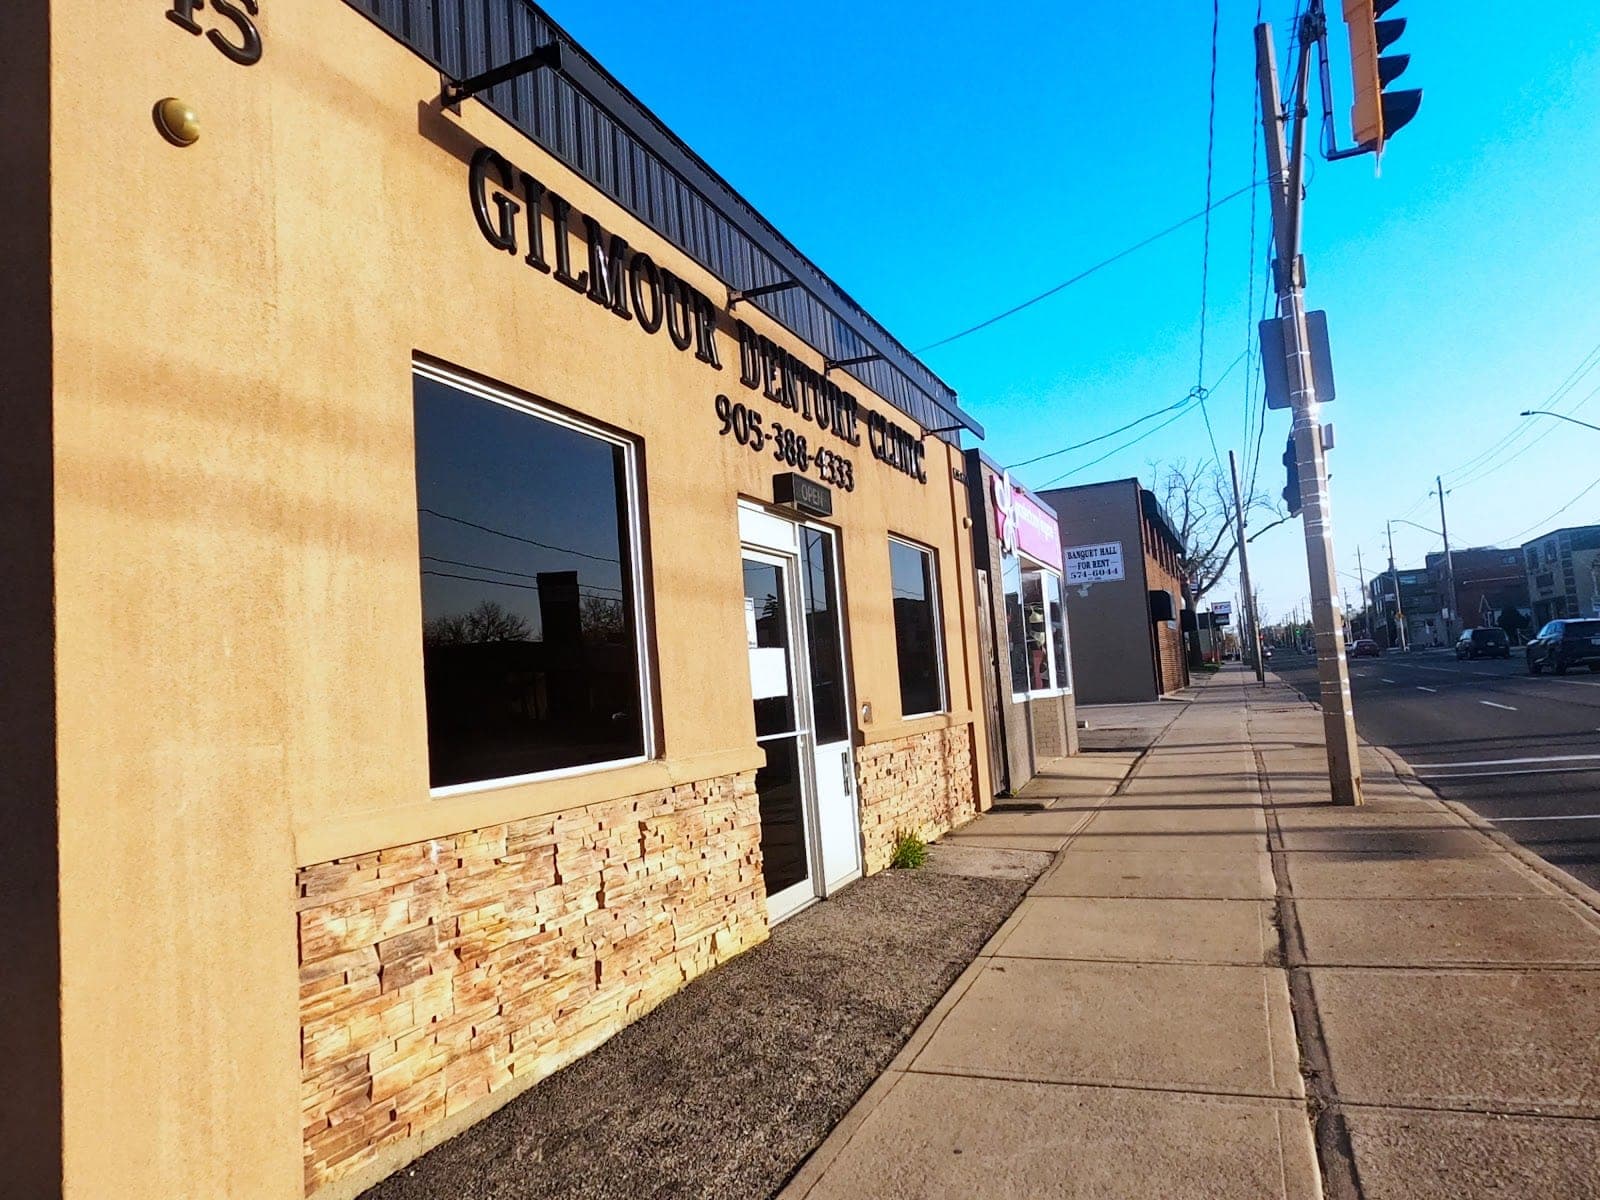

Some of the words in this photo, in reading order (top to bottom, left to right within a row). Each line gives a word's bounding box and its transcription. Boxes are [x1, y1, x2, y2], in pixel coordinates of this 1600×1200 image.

[469, 147, 723, 371] GILMOUR
[737, 319, 860, 447] DENTURE
[868, 410, 927, 484] CLINIC
[715, 394, 854, 492] 905-388-4333
[801, 484, 824, 505] OPEN
[1067, 549, 1097, 560] BANQUET
[1100, 547, 1117, 556] HALL
[1077, 561, 1091, 570] FOR
[1092, 559, 1109, 568] RENT
